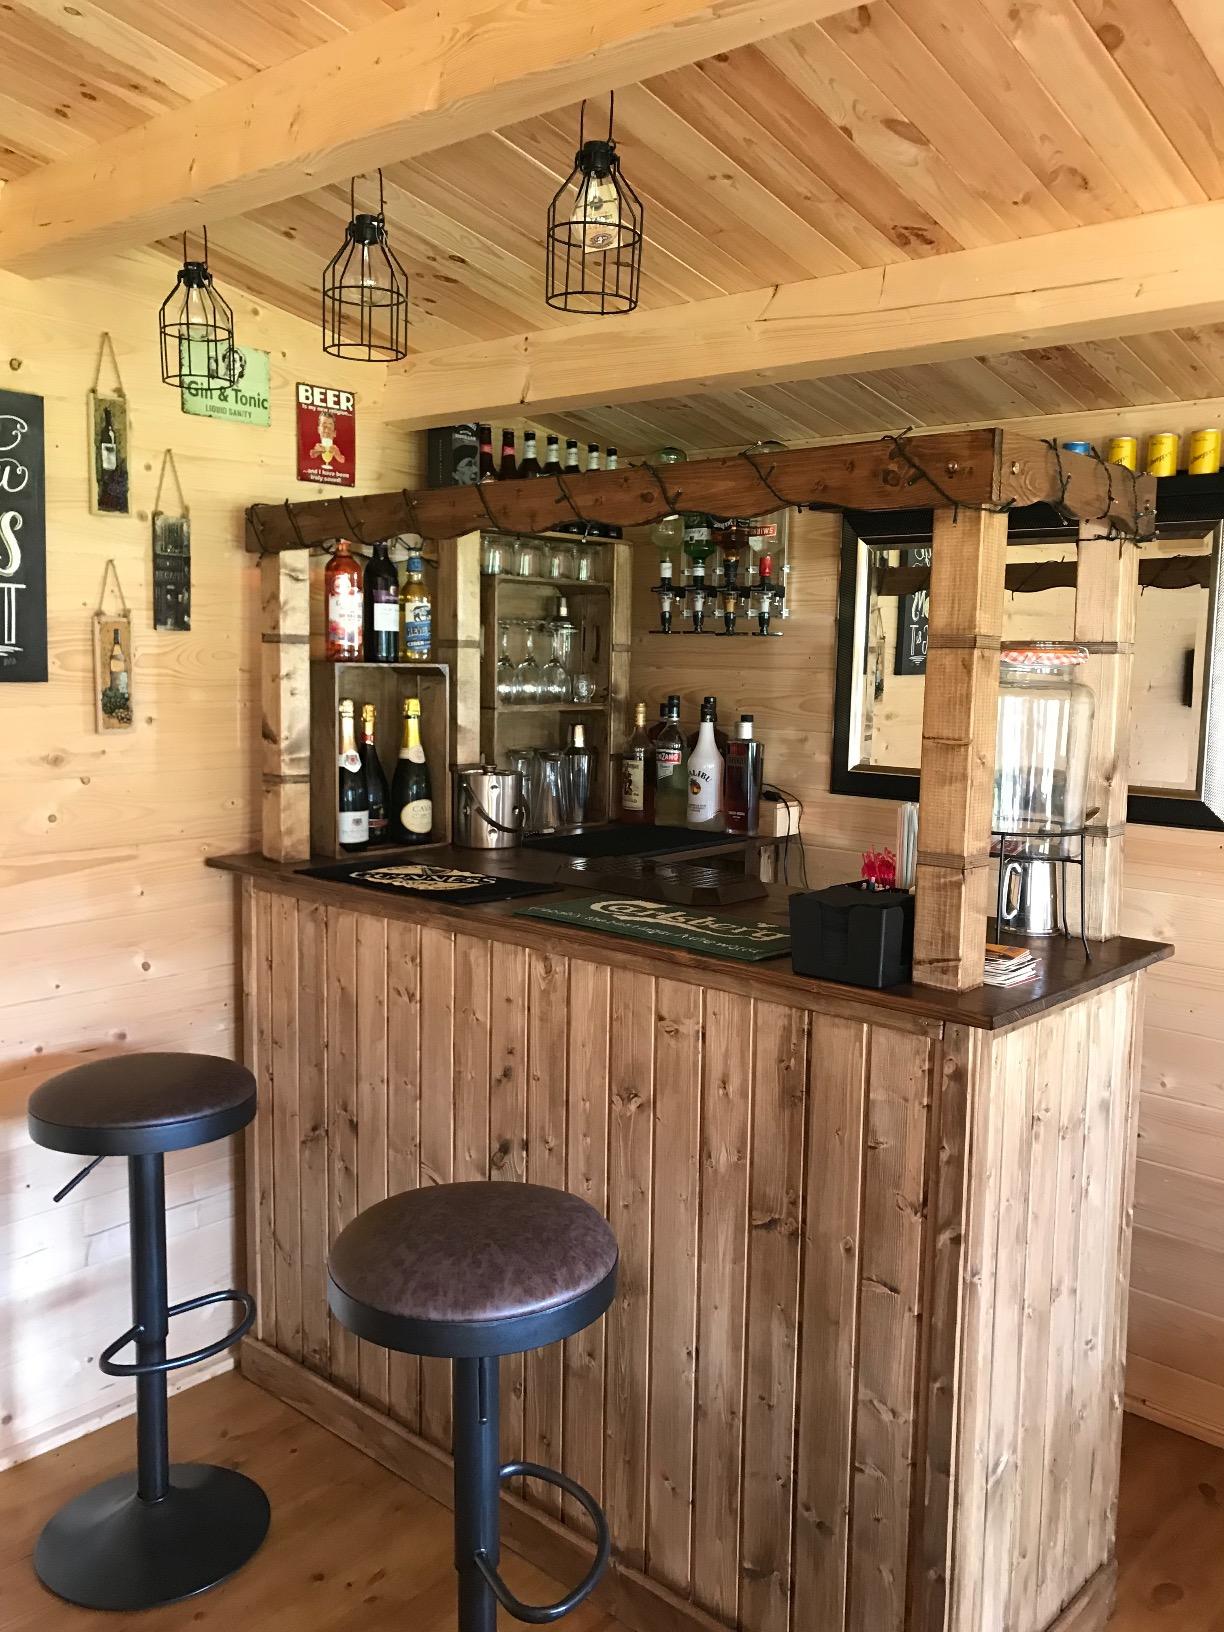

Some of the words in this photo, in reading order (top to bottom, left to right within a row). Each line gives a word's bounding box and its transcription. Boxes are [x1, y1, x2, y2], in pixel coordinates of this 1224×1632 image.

[187, 380, 213, 400] Gin
[218, 386, 229, 402] &
[232, 388, 268, 409] Tonic
[298, 384, 354, 411] BEER
[688, 769, 713, 783] ALIBU
[349, 871, 497, 884] GUINNESS
[590, 900, 791, 941] Carlsberg
